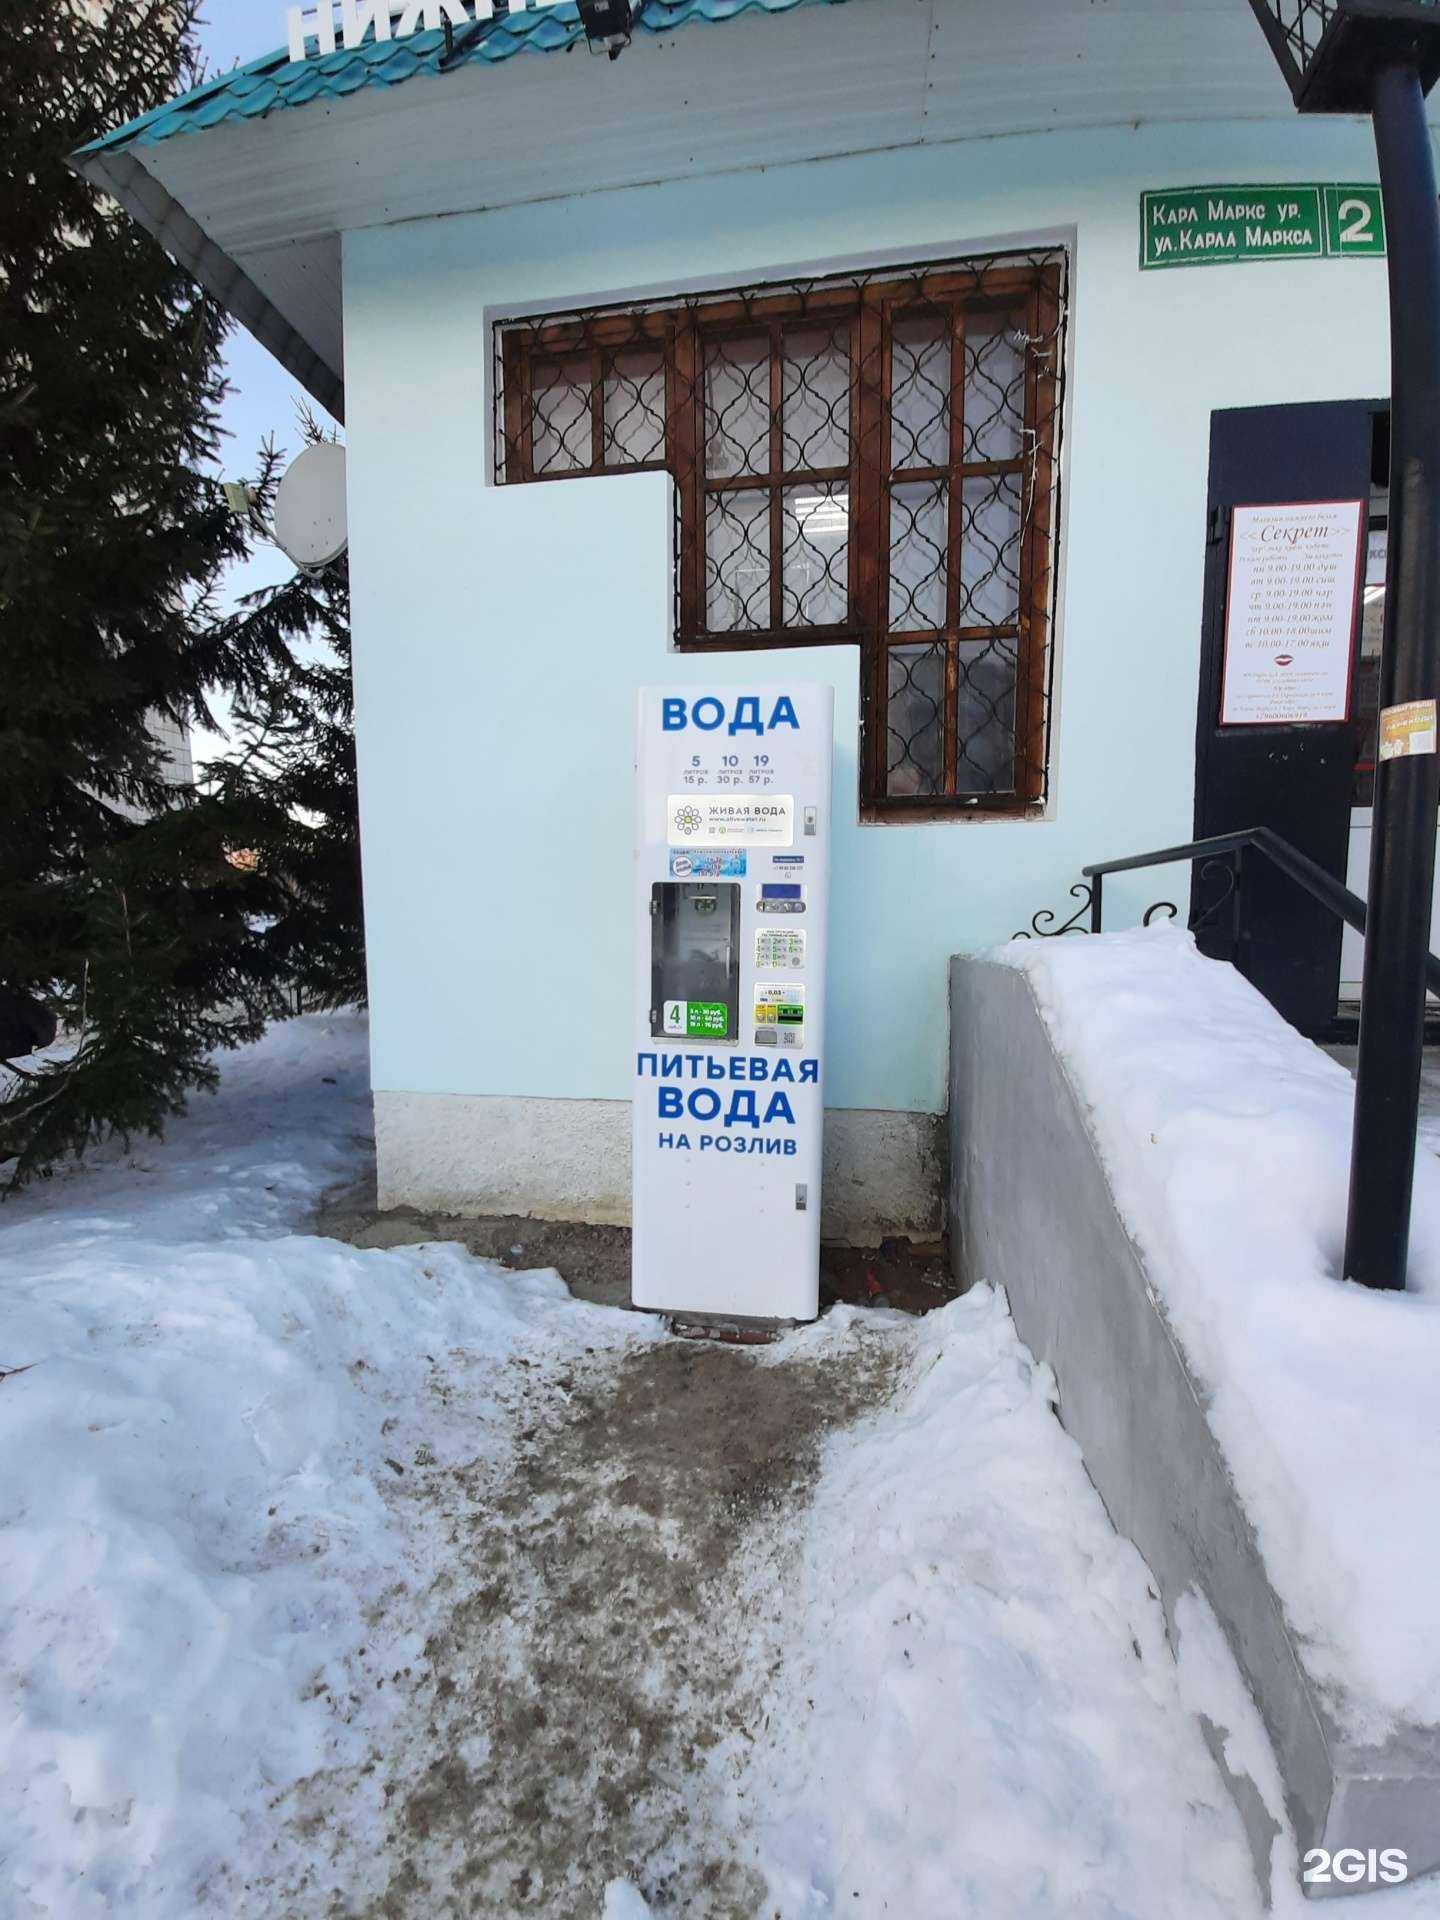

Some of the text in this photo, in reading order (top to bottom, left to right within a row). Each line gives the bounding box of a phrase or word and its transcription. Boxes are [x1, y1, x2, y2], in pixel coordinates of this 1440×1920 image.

[1338, 199, 1375, 243] 2
[662, 696, 800, 736] ВОДА
[691, 755, 769, 767] 5 10 19
[709, 807, 786, 816] ЖИВАЯ ВОДА
[670, 1004, 681, 1024] 4
[637, 1053, 819, 1083] ПИТЬЕВАЯ
[658, 1086, 796, 1129] ВОДА
[659, 1133, 797, 1155] НА РОЗЛИВ
